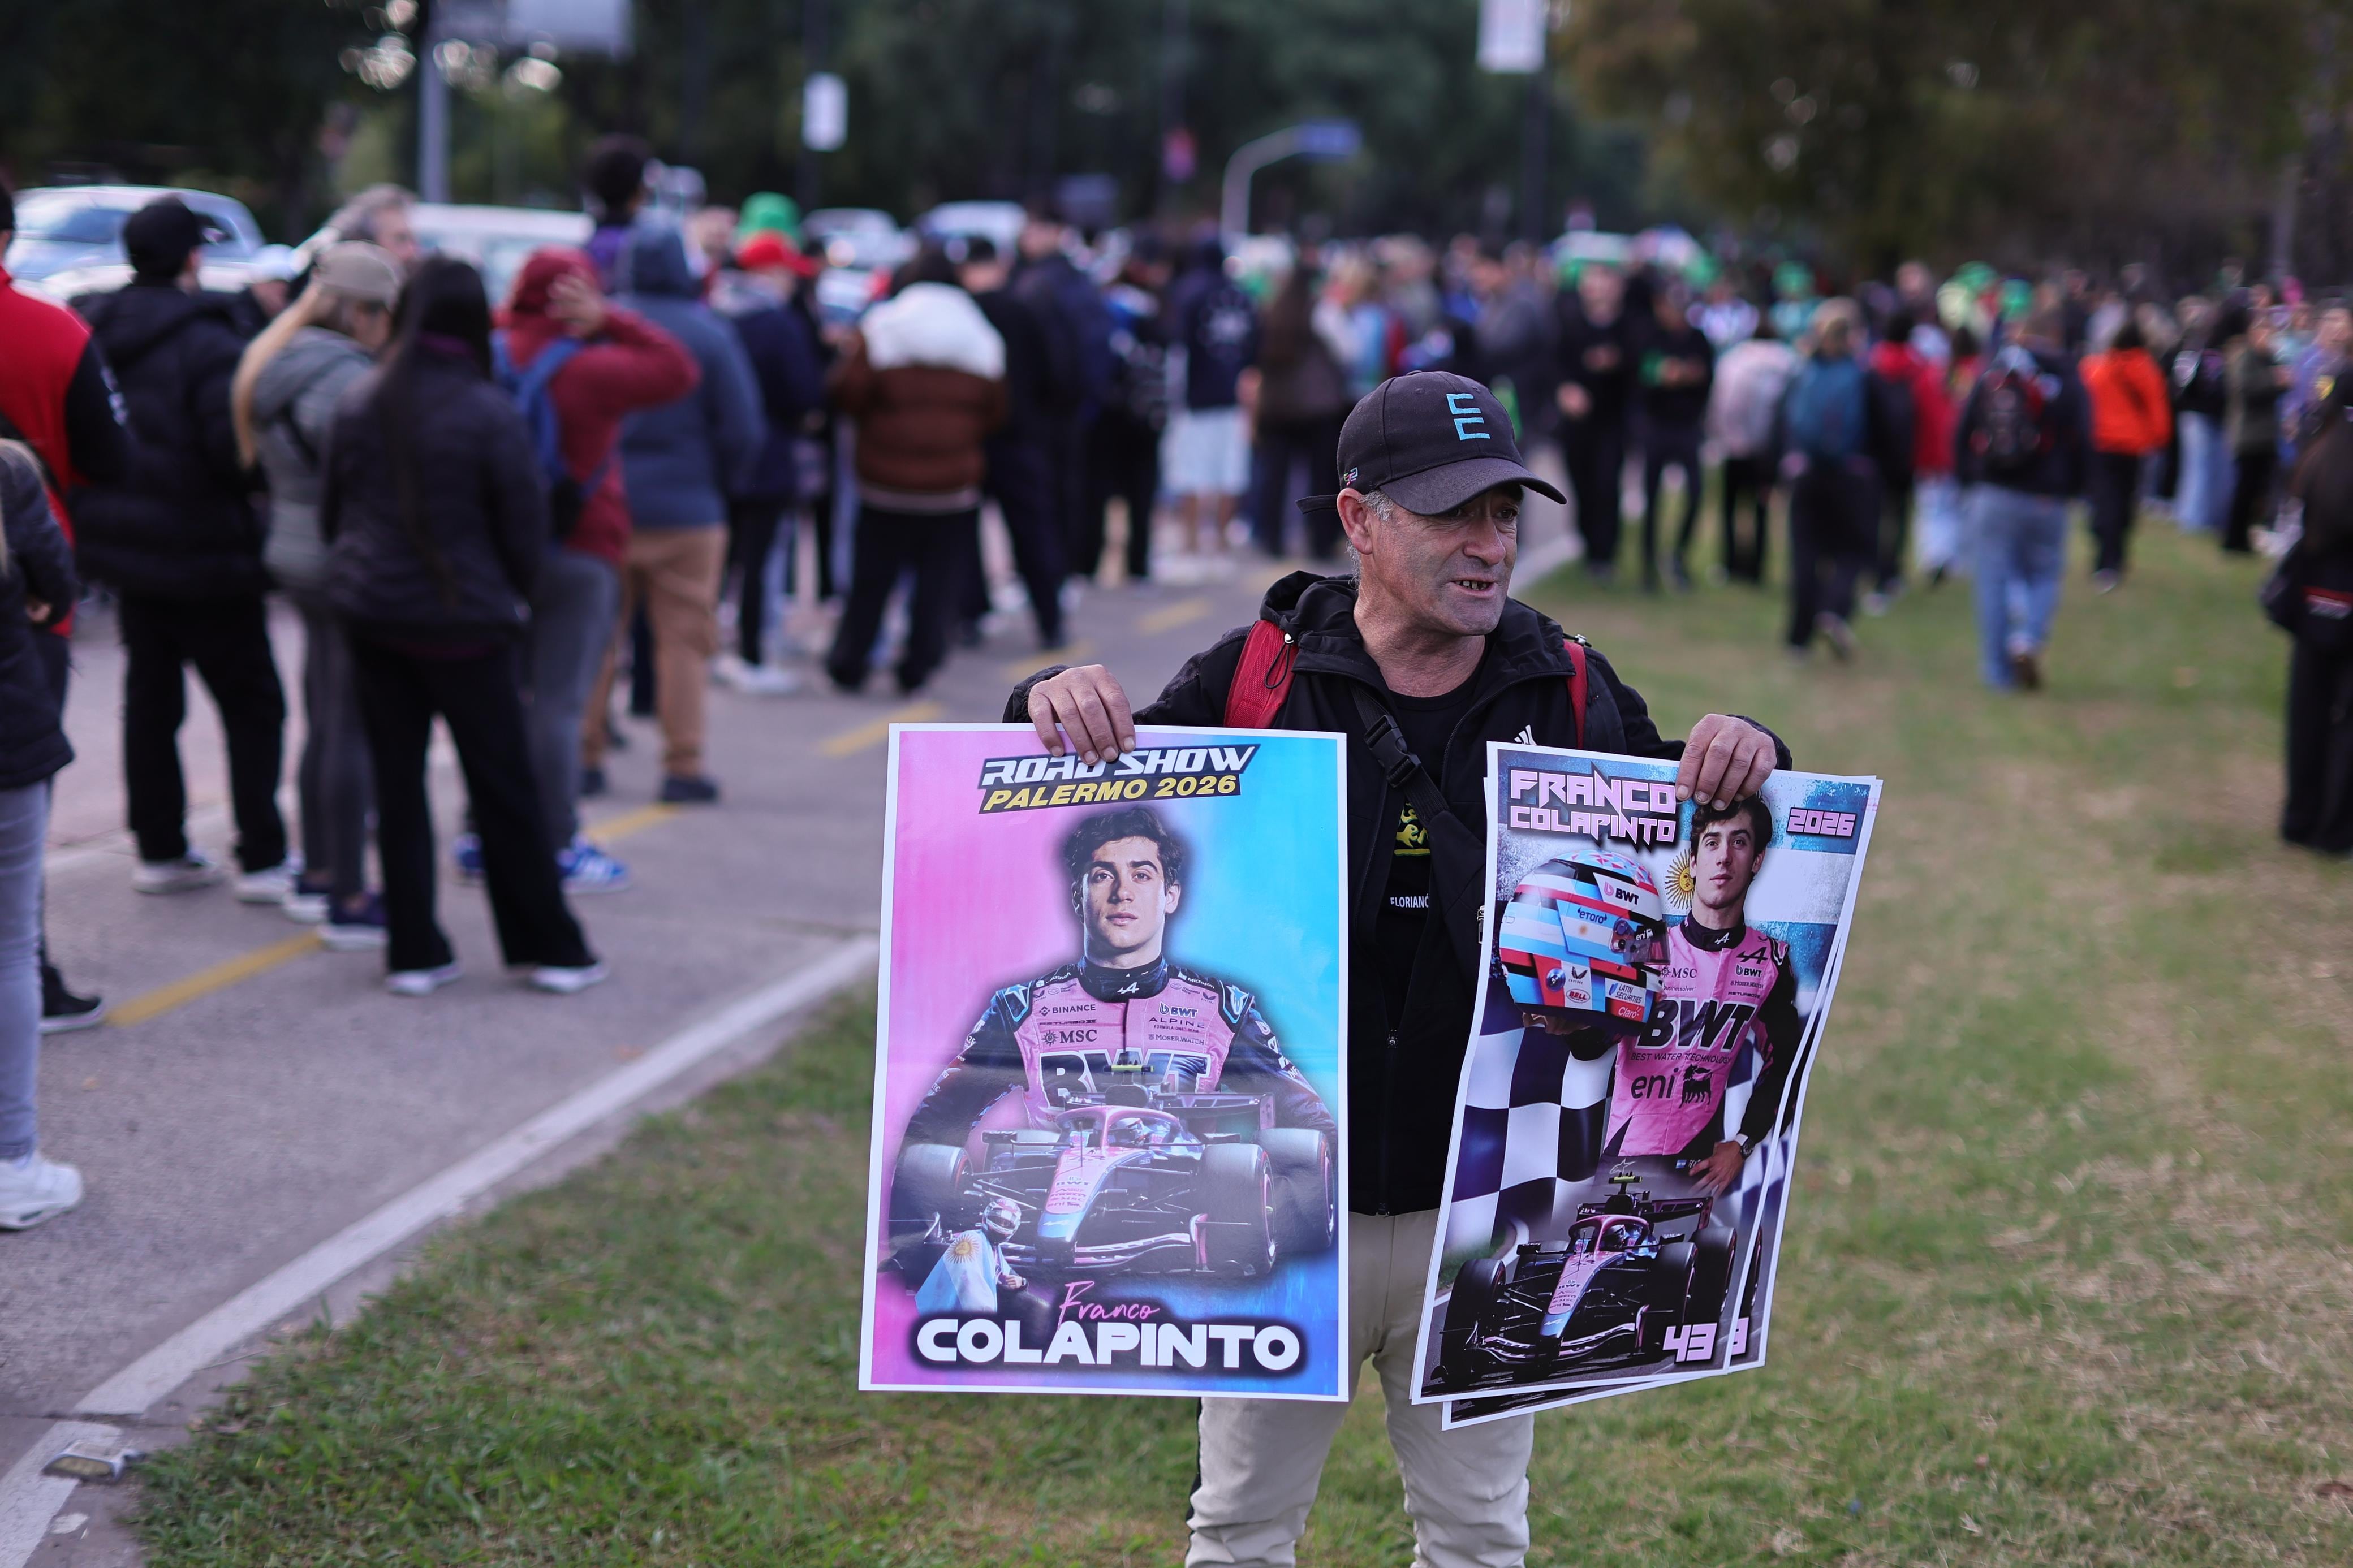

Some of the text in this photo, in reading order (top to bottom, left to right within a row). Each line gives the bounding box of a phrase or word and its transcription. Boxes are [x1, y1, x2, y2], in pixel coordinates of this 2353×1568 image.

[1114, 746, 1256, 776] SHOW
[982, 775, 1237, 811] PALERMO 2026
[1510, 769, 1677, 814] FRANCO
[1510, 805, 1677, 845] COLAPINTO
[1786, 807, 1856, 837] 2026
[1615, 888, 1639, 905] BWT
[1636, 930, 1647, 940] eni
[1671, 967, 1697, 978] MSC
[1744, 967, 1762, 978] BWT
[1569, 991, 1587, 1000] BELL
[1618, 983, 1634, 994] LATIN
[1615, 991, 1642, 1004] SECURITIES
[1052, 1004, 1096, 1014] BINANCE
[1170, 1006, 1199, 1018] BWT
[1618, 1007, 1637, 1018] Claro
[1149, 1017, 1205, 1029] ALPINE
[1635, 997, 1758, 1052] BWT
[1059, 1029, 1097, 1043] MSC
[1684, 1053, 1732, 1064] TECHNOLOGY
[1040, 1047, 1211, 1112] BWT
[1631, 1067, 1679, 1099] eni
[1057, 1280, 1160, 1331] Franco
[916, 1318, 1300, 1371] COLAPINTO
[1662, 1322, 1718, 1362] 43
